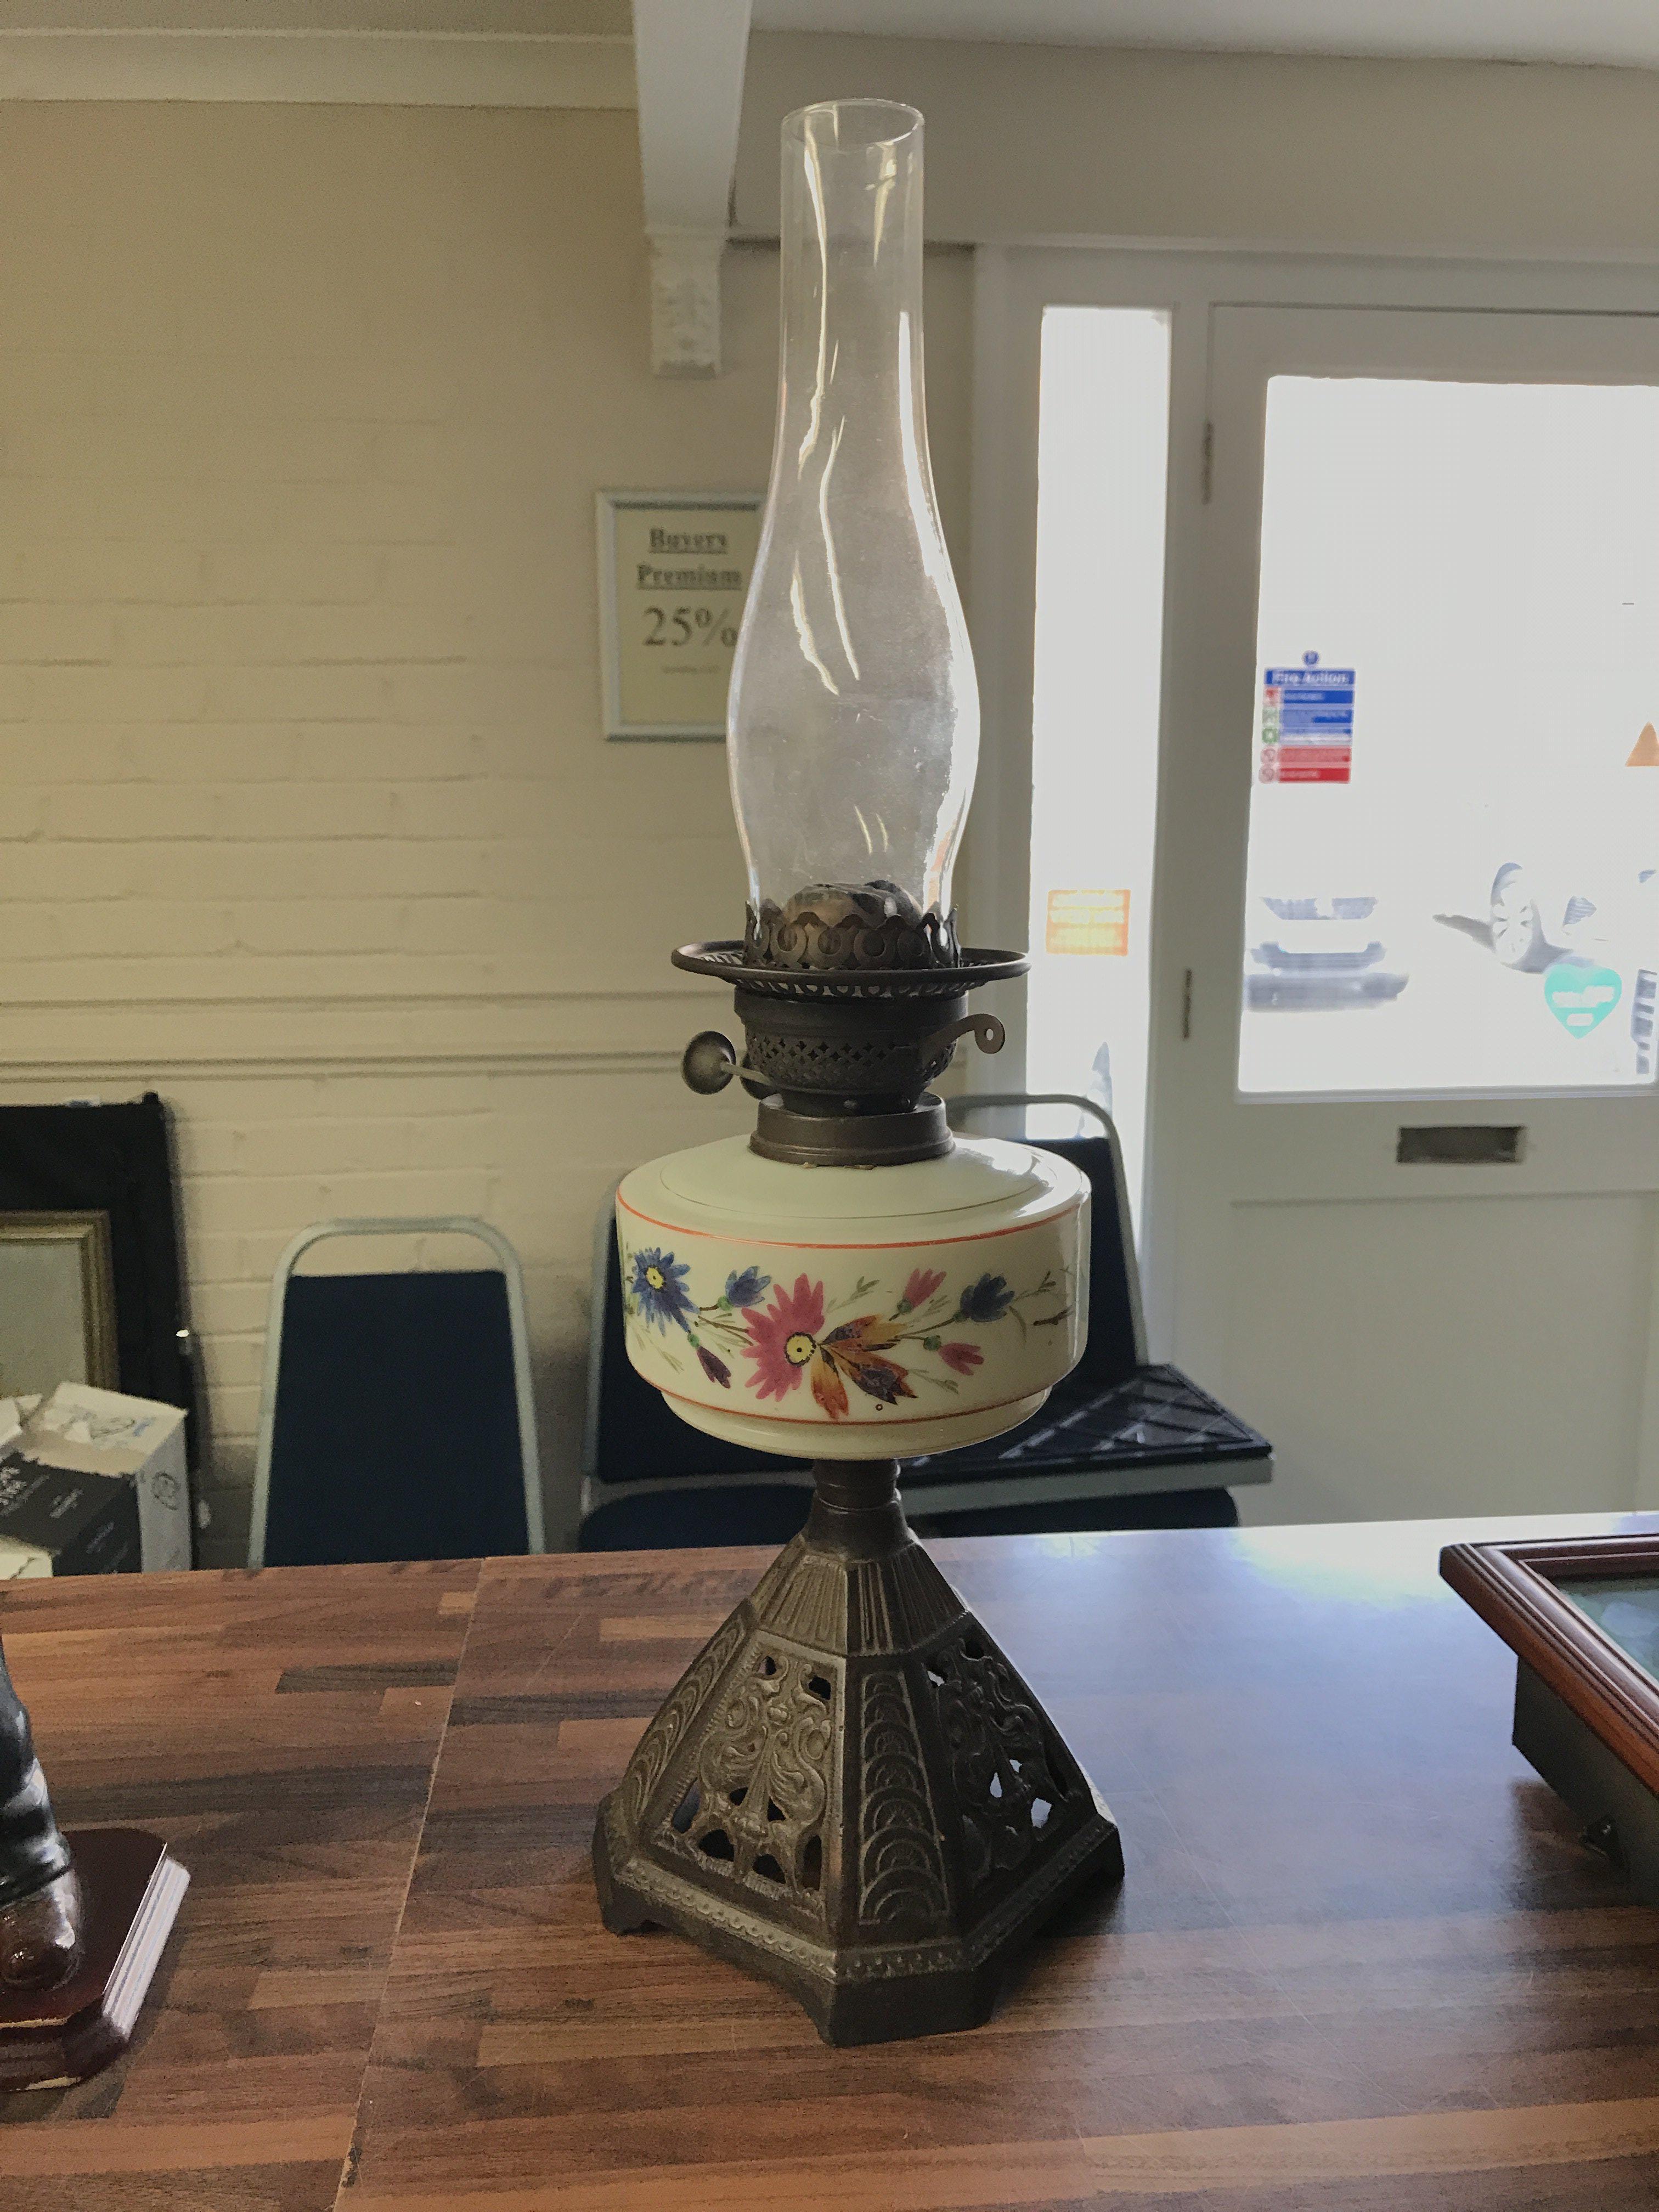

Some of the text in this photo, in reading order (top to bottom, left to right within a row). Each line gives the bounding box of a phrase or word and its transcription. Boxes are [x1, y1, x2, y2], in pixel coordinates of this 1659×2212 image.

[649, 528, 728, 552] Buyers
[637, 563, 742, 589] Premium
[642, 606, 738, 647] 25%
